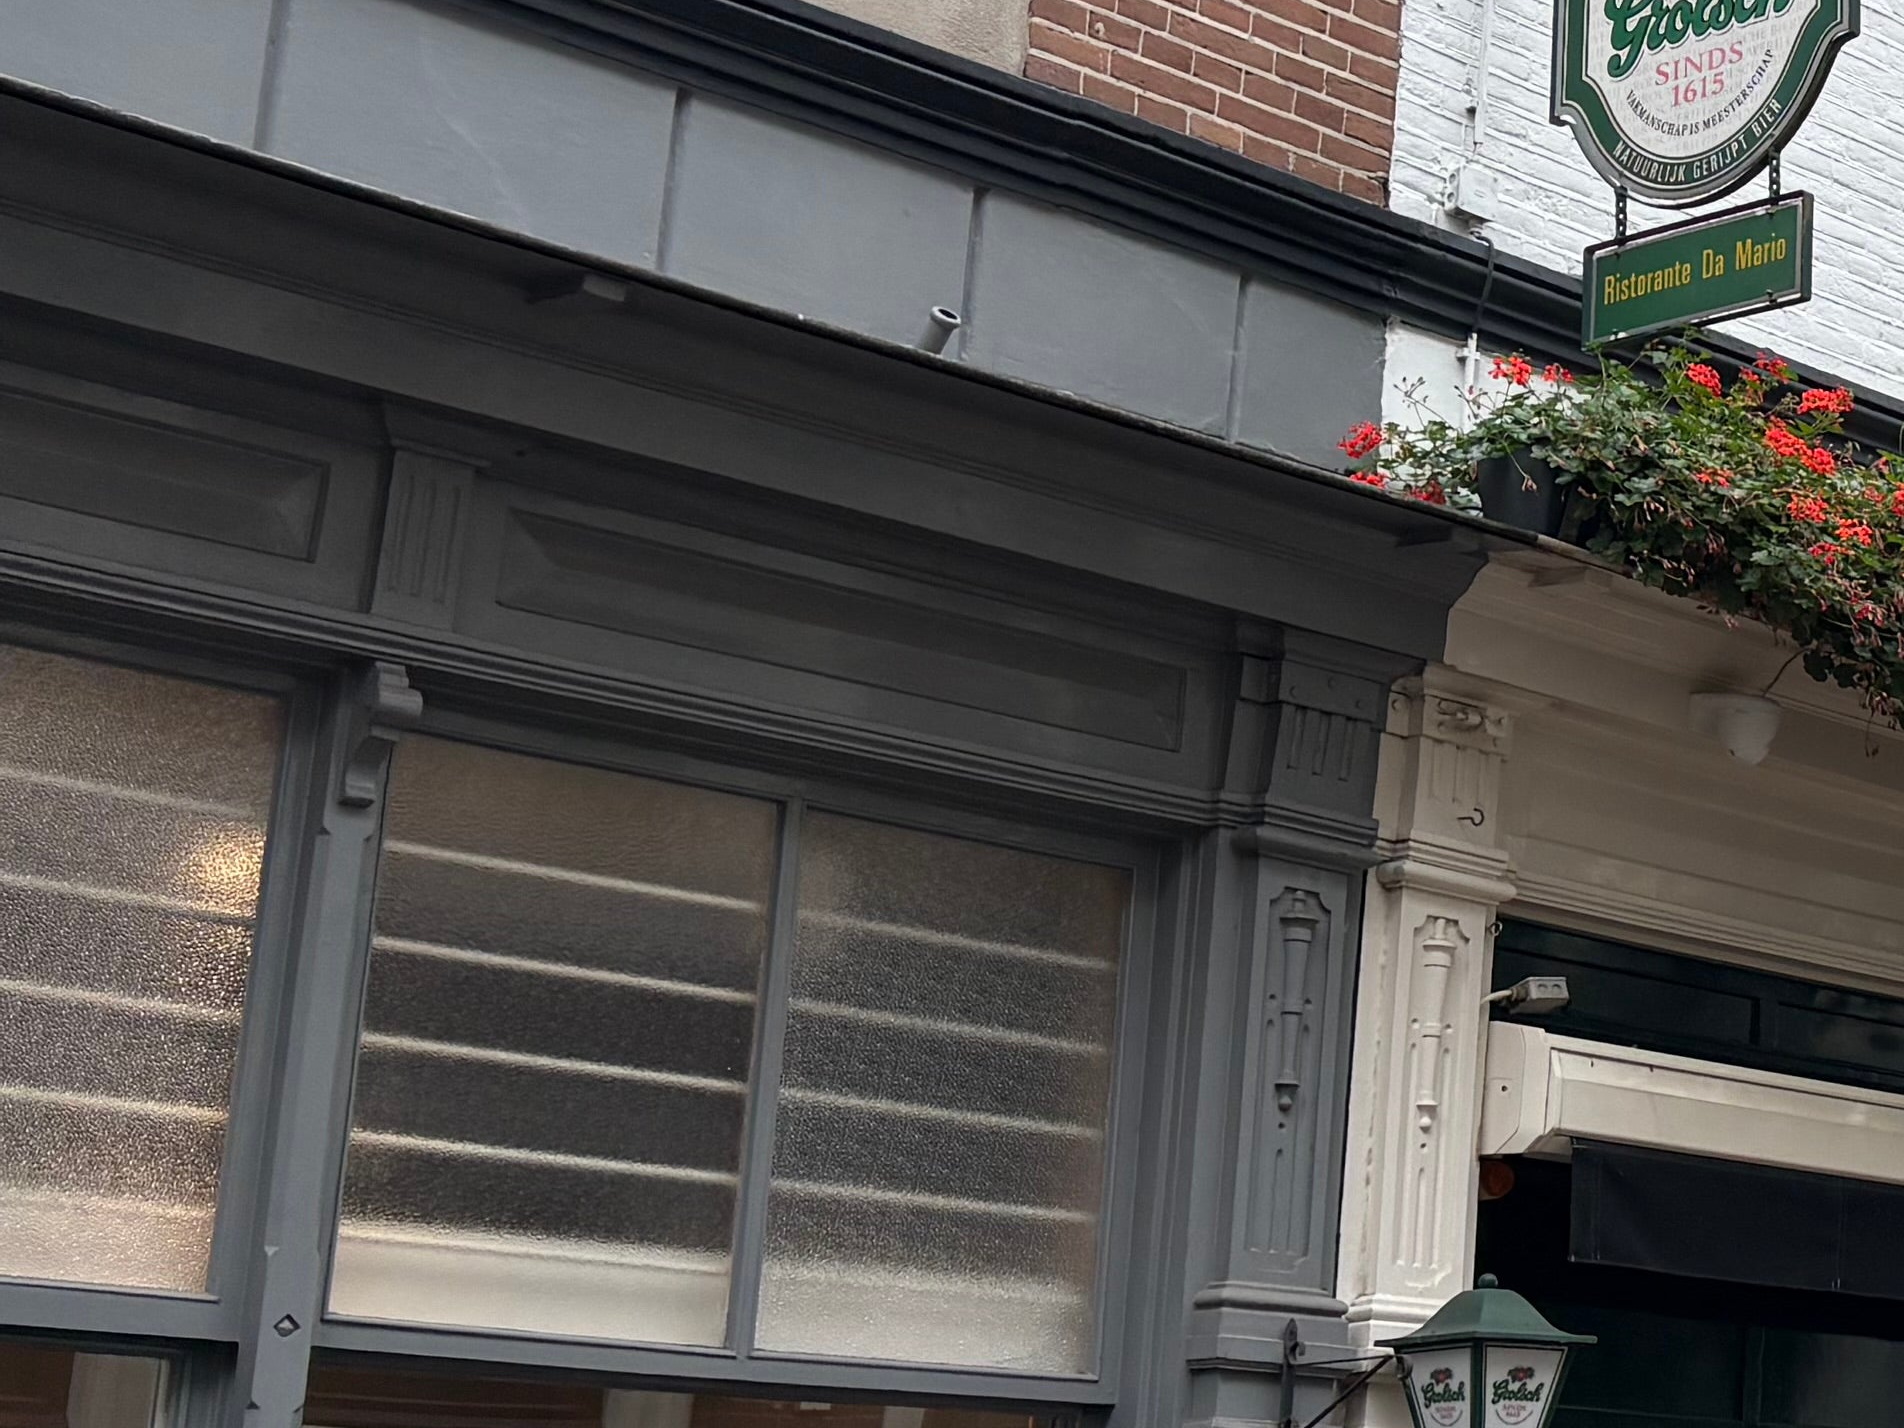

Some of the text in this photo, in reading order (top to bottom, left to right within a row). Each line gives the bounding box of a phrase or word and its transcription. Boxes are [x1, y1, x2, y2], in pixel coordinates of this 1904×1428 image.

[1655, 40, 1744, 86] SINDS
[1671, 72, 1725, 108] 1615
[1626, 49, 1774, 137] VAKMANSCHAP IS MEESTERSCHAP
[1612, 99, 1783, 182] NATUURLIJK GERIJPT BIER
[1603, 233, 1787, 306] Ristorante Da Mario
[1491, 1380, 1545, 1404] Grolsch
